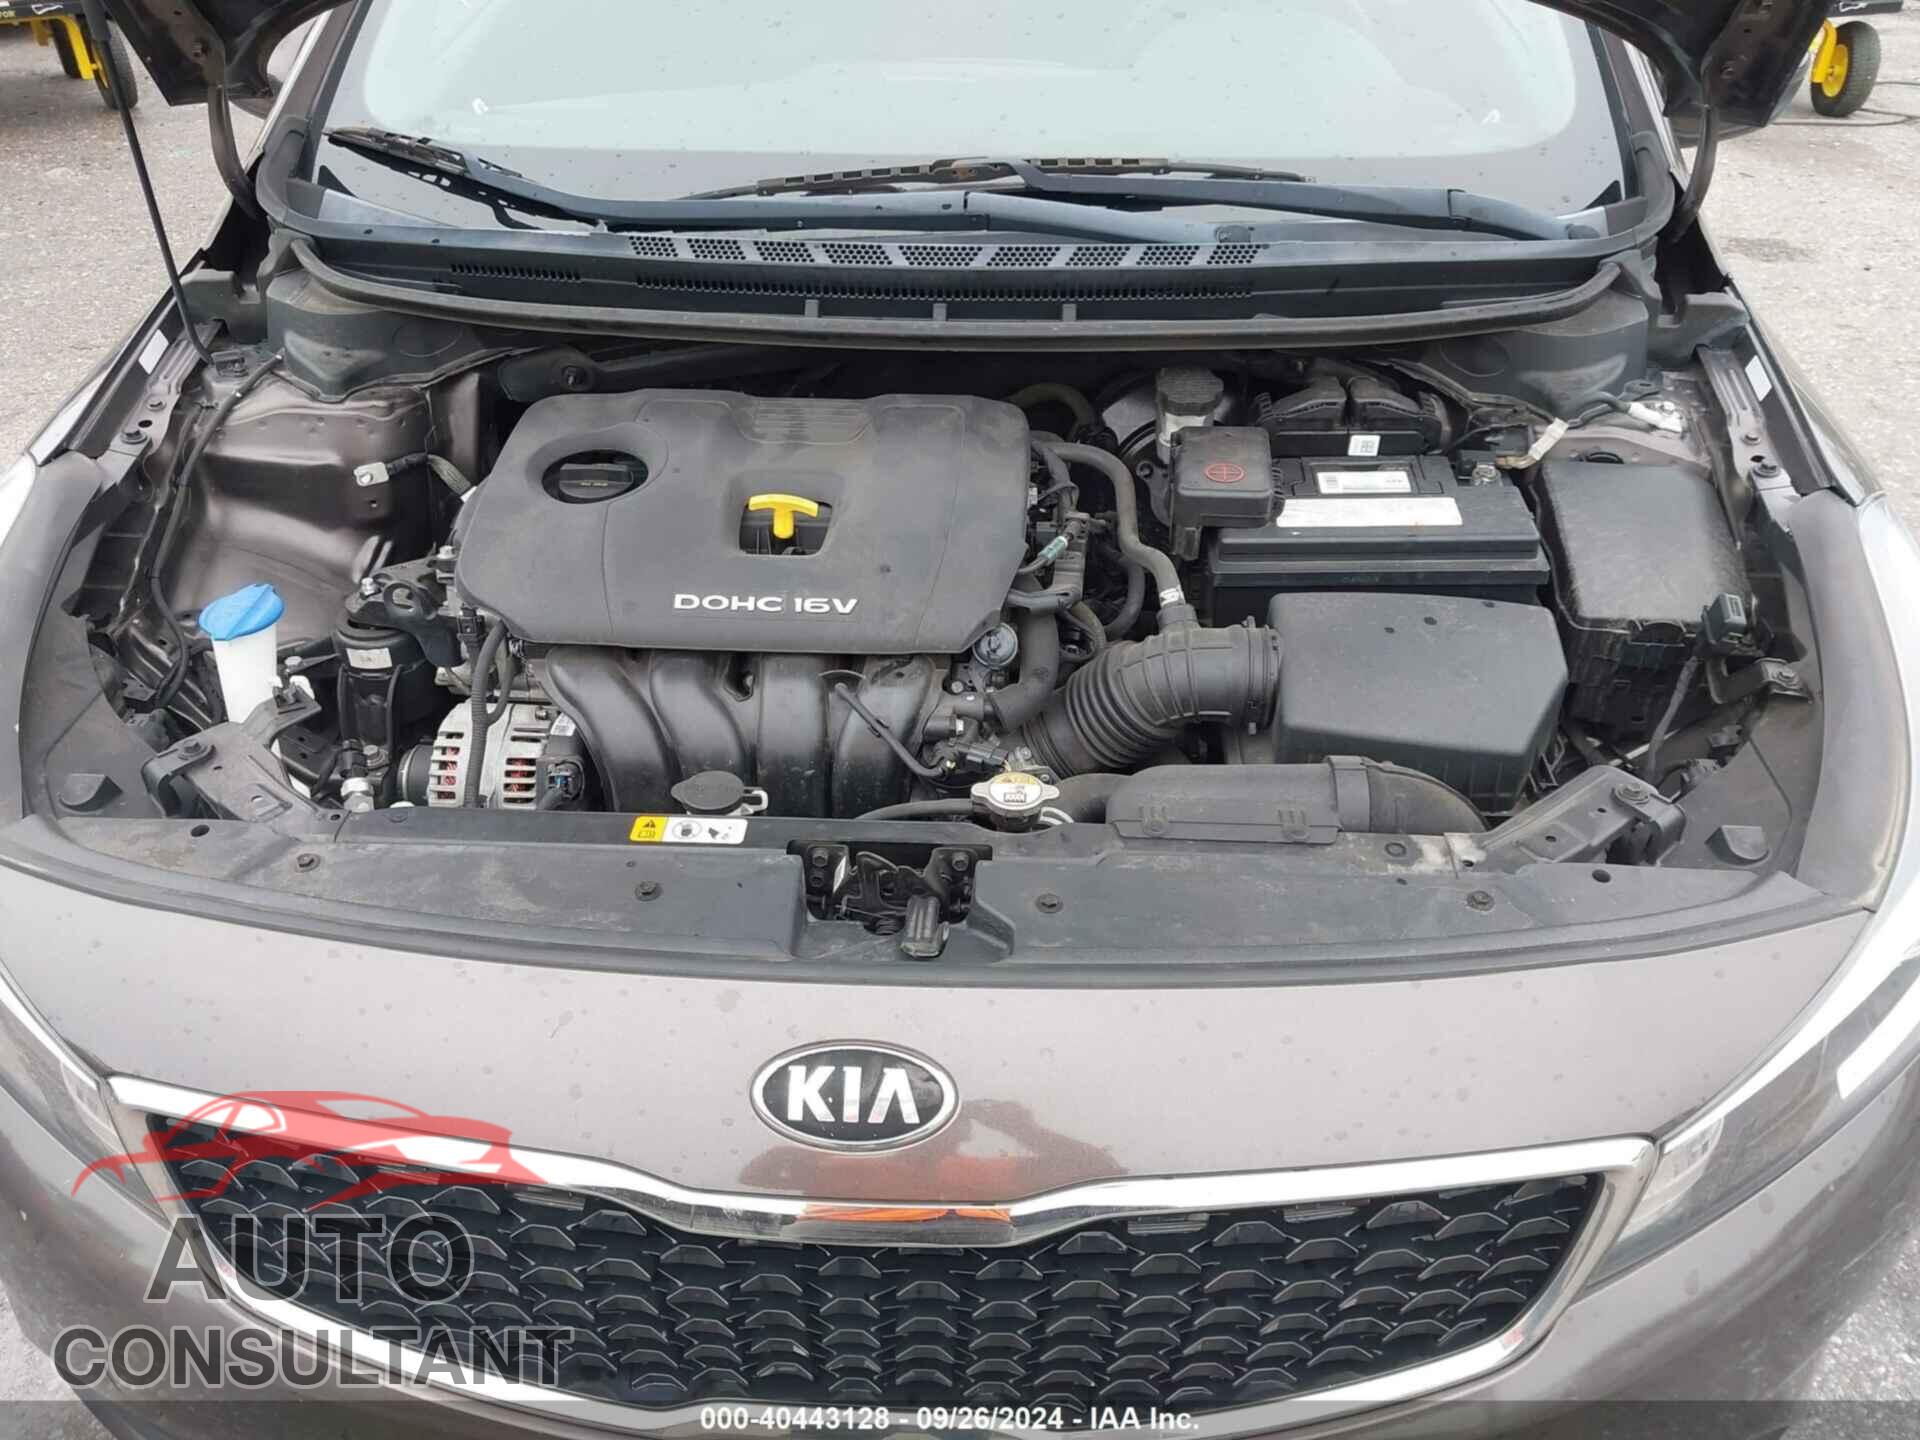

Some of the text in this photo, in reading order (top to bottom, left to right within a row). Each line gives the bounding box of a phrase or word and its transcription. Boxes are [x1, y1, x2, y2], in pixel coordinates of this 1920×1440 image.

[673, 593, 859, 615] DOHC 16V
[787, 1065, 920, 1124] KIA
